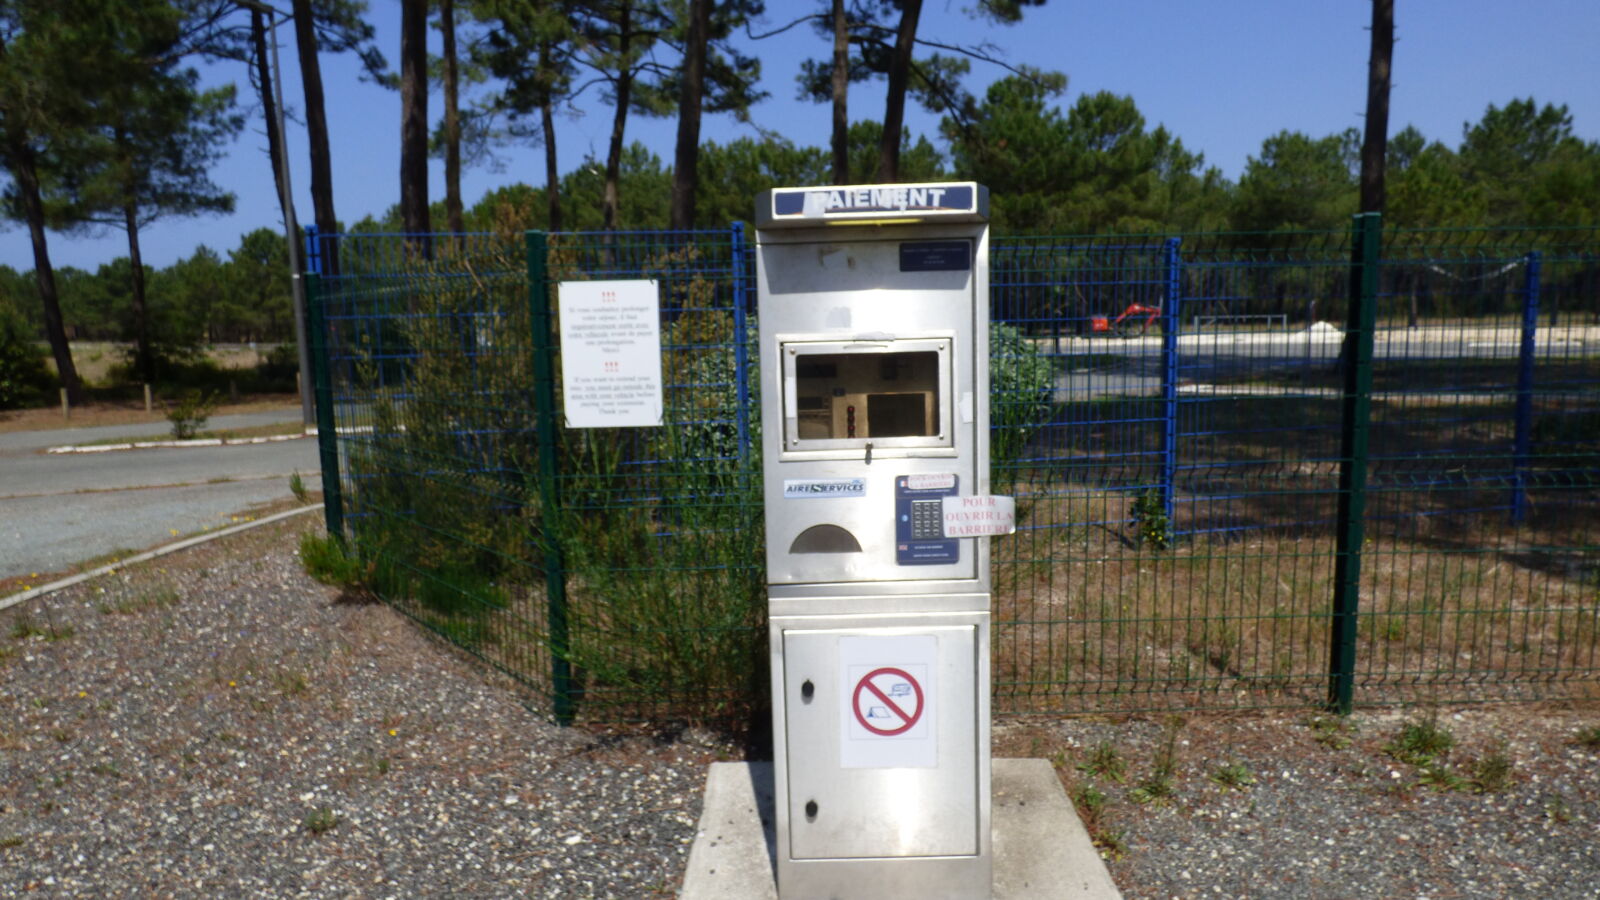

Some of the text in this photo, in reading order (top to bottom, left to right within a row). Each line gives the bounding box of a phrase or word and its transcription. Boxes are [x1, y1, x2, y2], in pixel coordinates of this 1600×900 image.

[806, 188, 946, 210] AIEMENT
[962, 497, 997, 508] POUR
[945, 510, 1014, 521] OUVRIR LA
